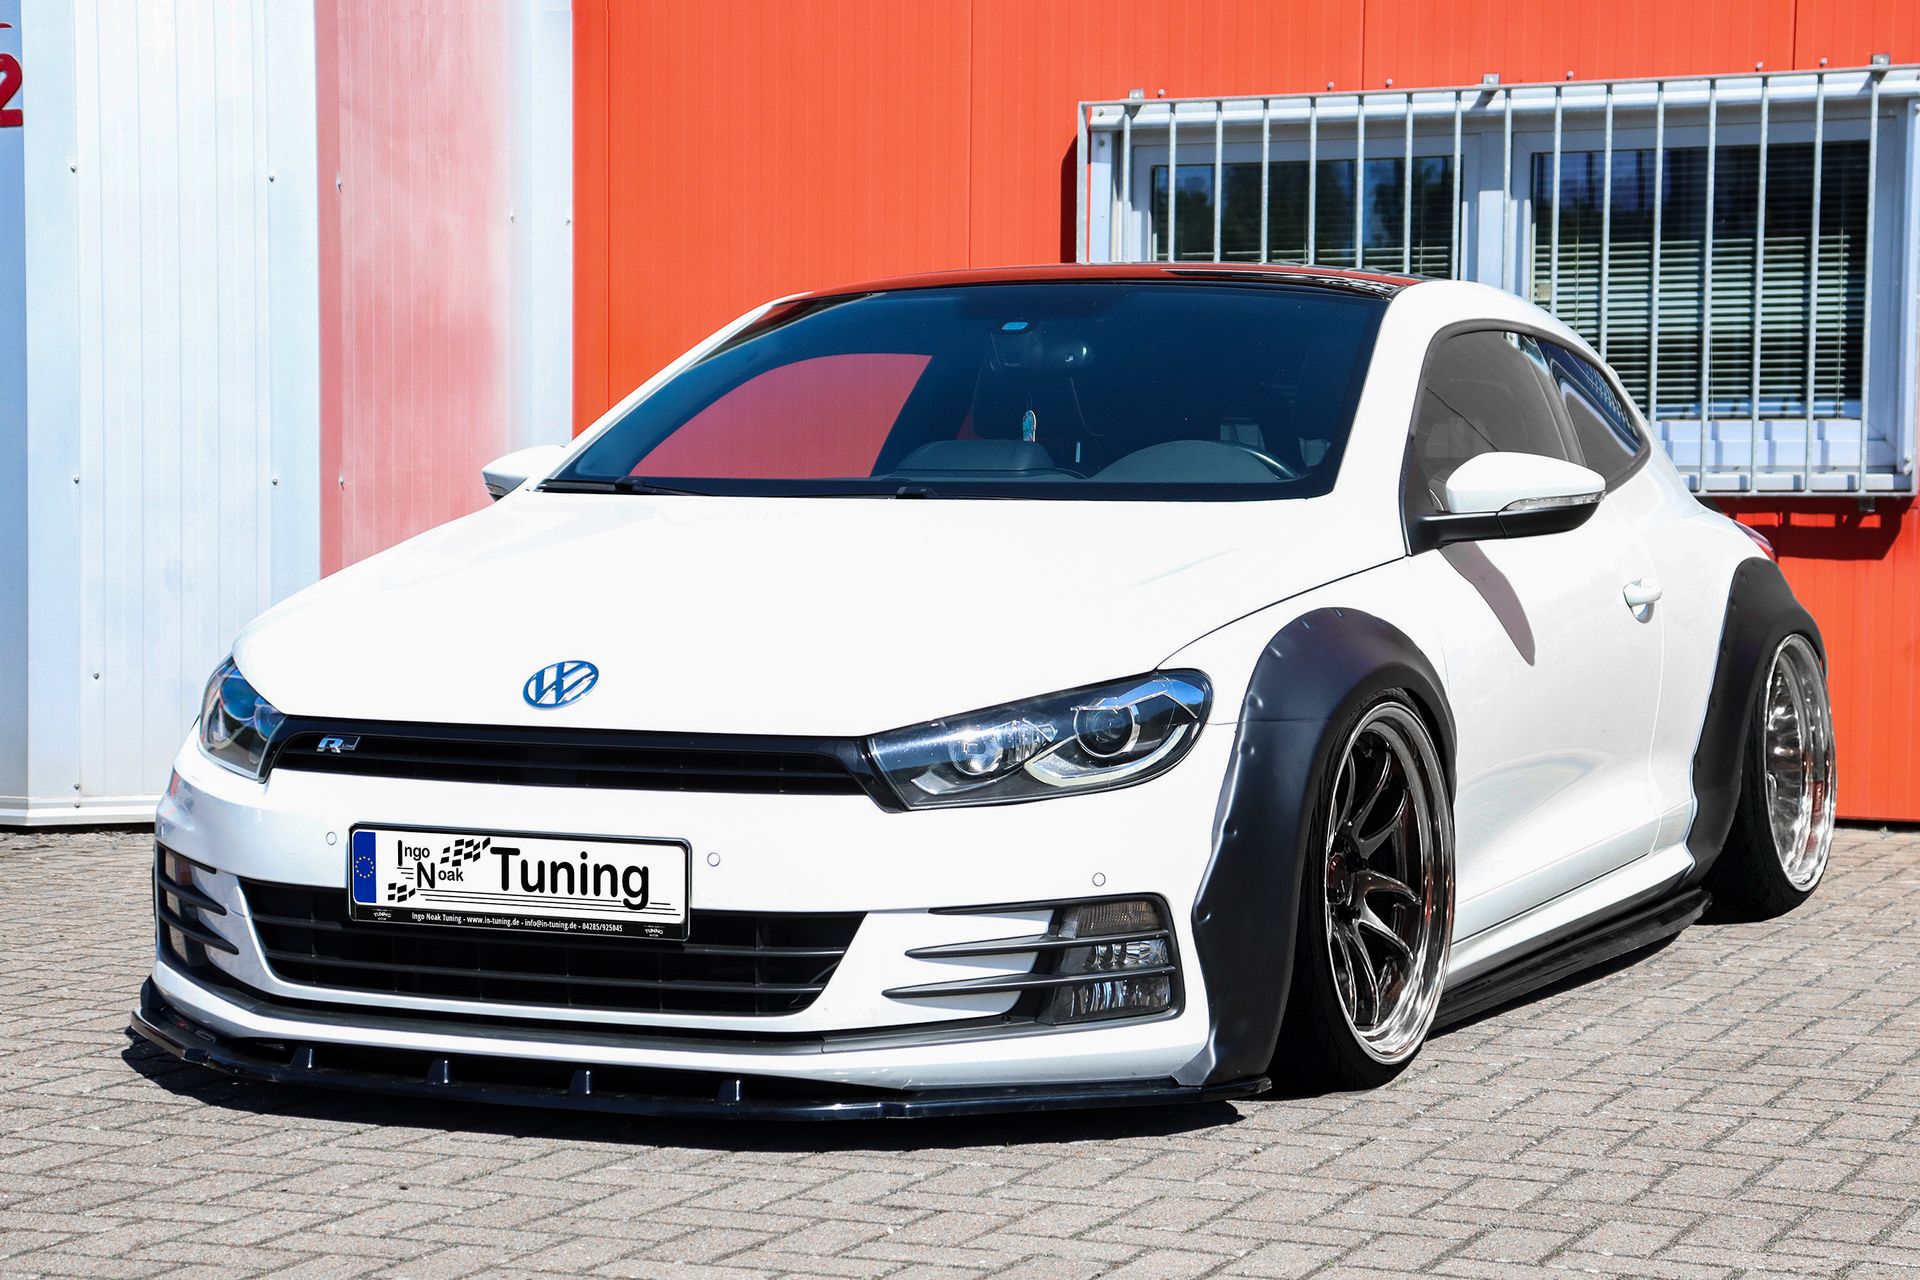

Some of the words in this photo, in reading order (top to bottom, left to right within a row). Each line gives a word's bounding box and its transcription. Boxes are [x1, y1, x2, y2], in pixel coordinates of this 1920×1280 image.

[0, 53, 23, 127] 2
[316, 737, 343, 753] R
[398, 840, 430, 866] Ingo
[417, 862, 464, 889] Noak
[490, 847, 649, 910] Tuning
[412, 912, 425, 922] Ingo
[426, 913, 442, 921] Noak
[443, 914, 462, 924] Tuning
[467, 916, 519, 927] www.in-tuning.de
[524, 919, 577, 931] info@in-tuning.de
